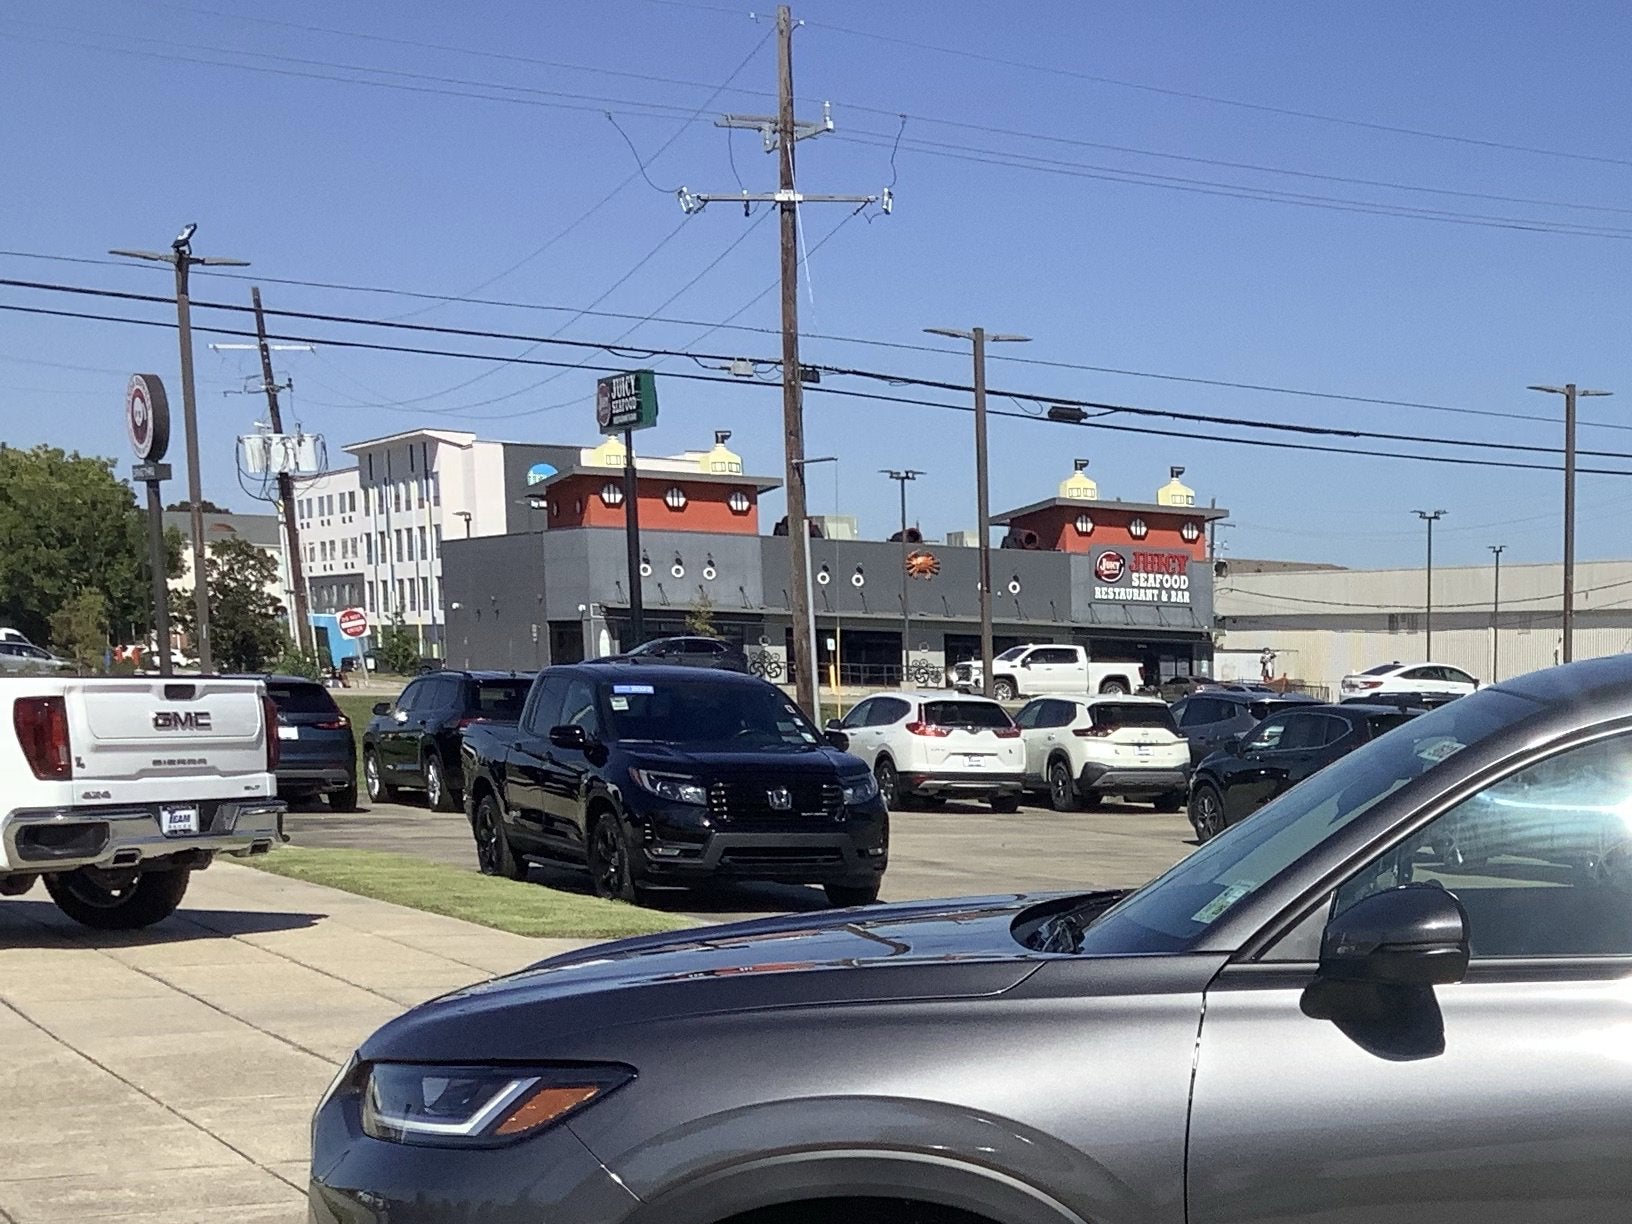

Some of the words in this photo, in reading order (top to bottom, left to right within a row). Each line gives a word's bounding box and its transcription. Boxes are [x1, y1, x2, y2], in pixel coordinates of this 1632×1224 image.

[611, 375, 635, 400] JUICY
[1129, 551, 1189, 575] JUICY
[1132, 573, 1189, 589] SEAFOOD
[1094, 587, 1159, 602] RESTAURANT
[1161, 591, 1169, 602] &
[1171, 591, 1190, 603] BAR
[152, 711, 212, 731] GMC
